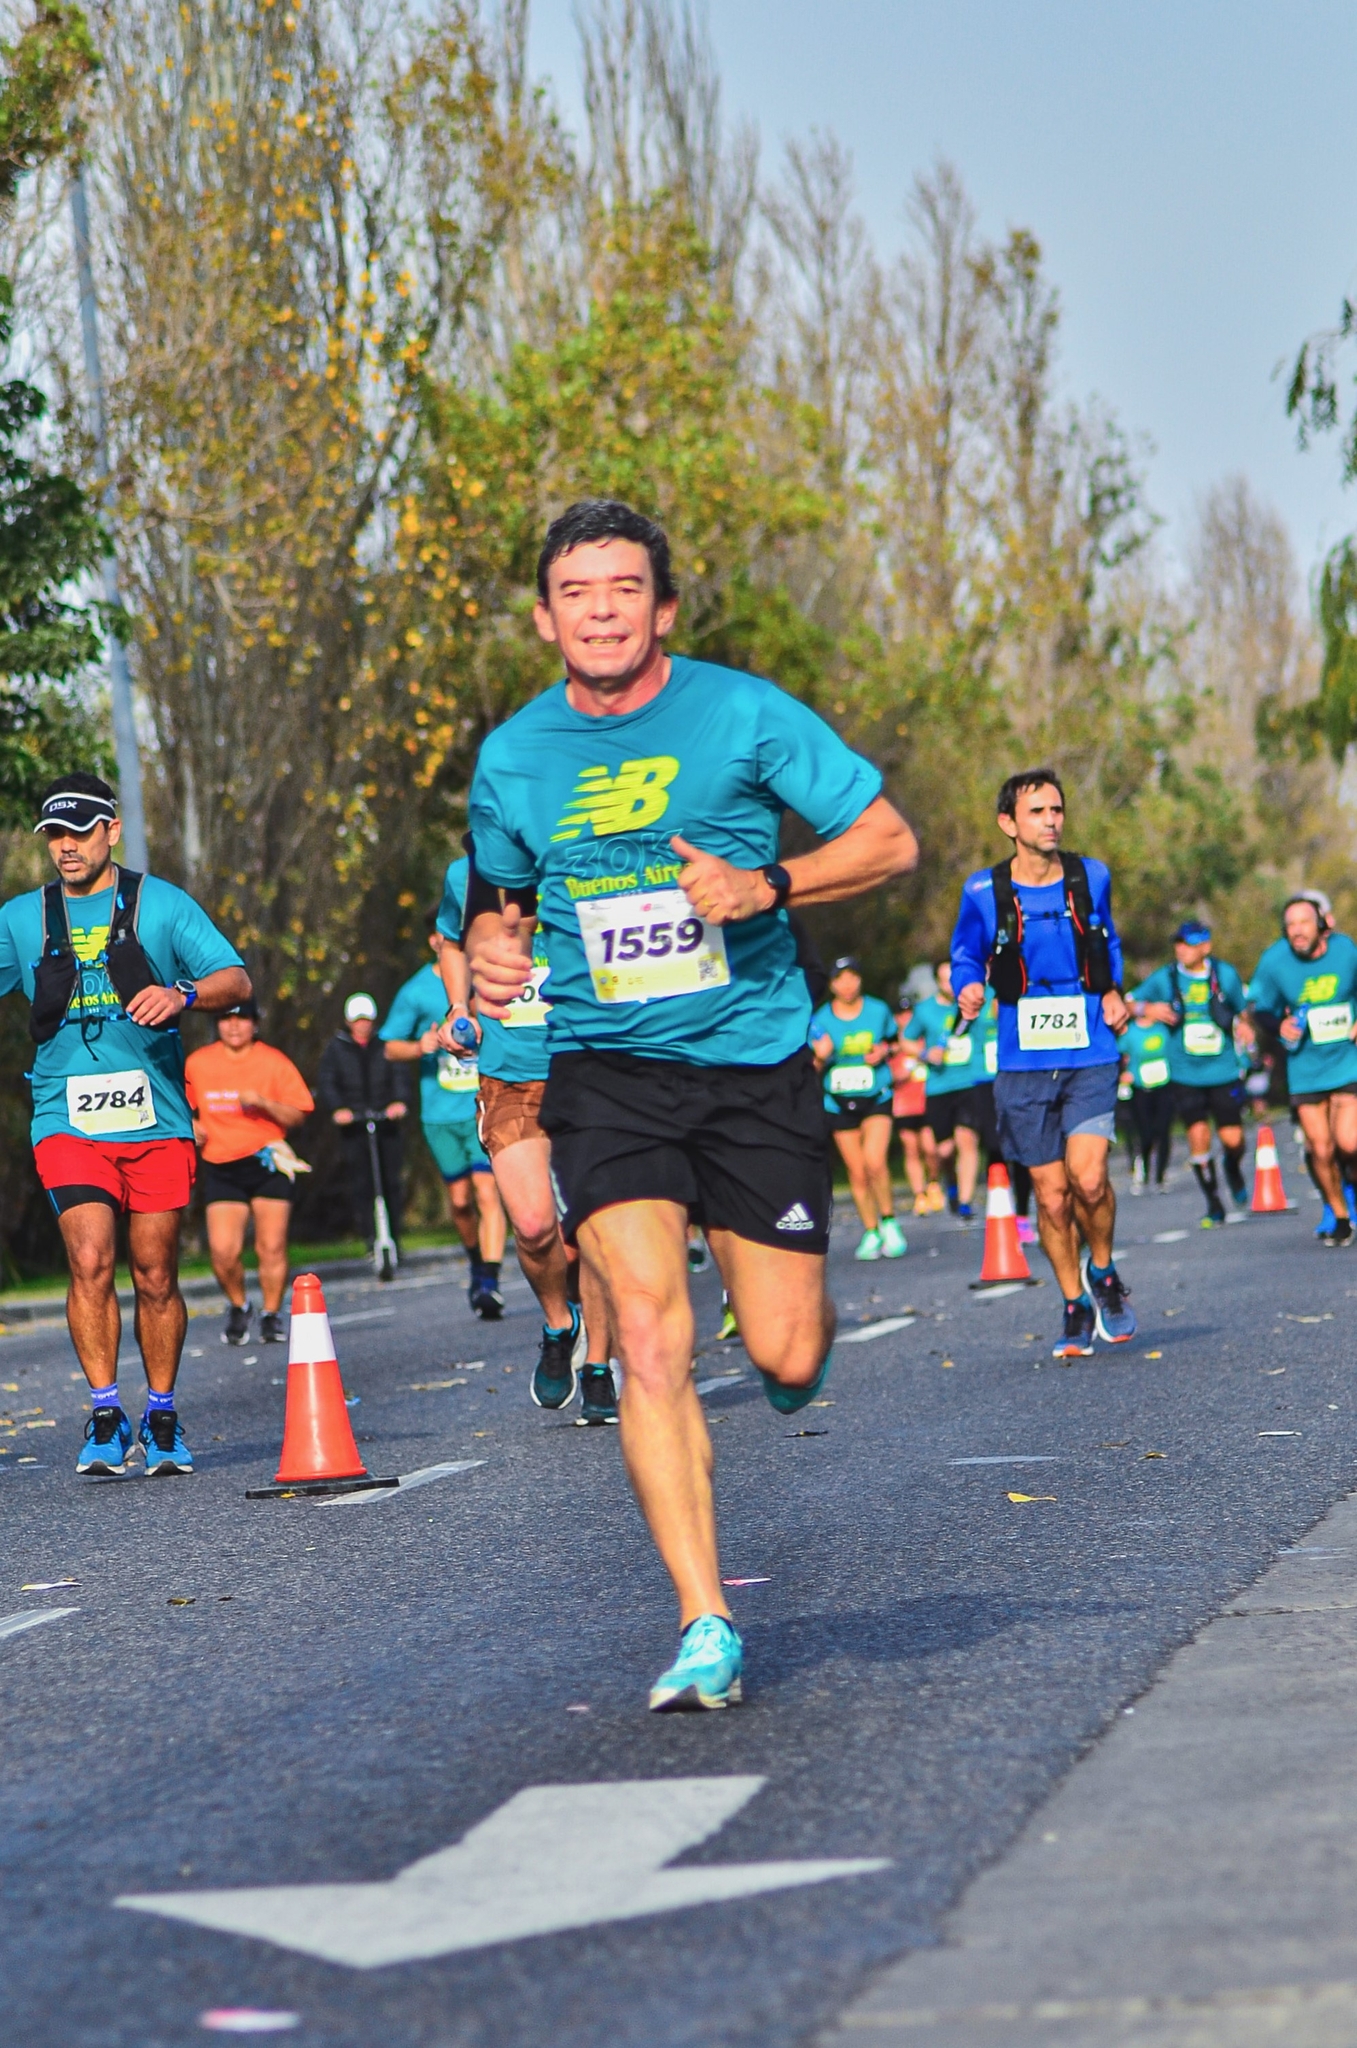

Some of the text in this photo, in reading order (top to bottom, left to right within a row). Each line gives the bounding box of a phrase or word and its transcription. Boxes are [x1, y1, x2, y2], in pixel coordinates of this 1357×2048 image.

[564, 872, 638, 899] Buenos
[600, 917, 704, 964] 1559
[1030, 1011, 1079, 1030] 1782
[76, 1085, 146, 1113] 2784
[775, 1220, 815, 1231] adidas
